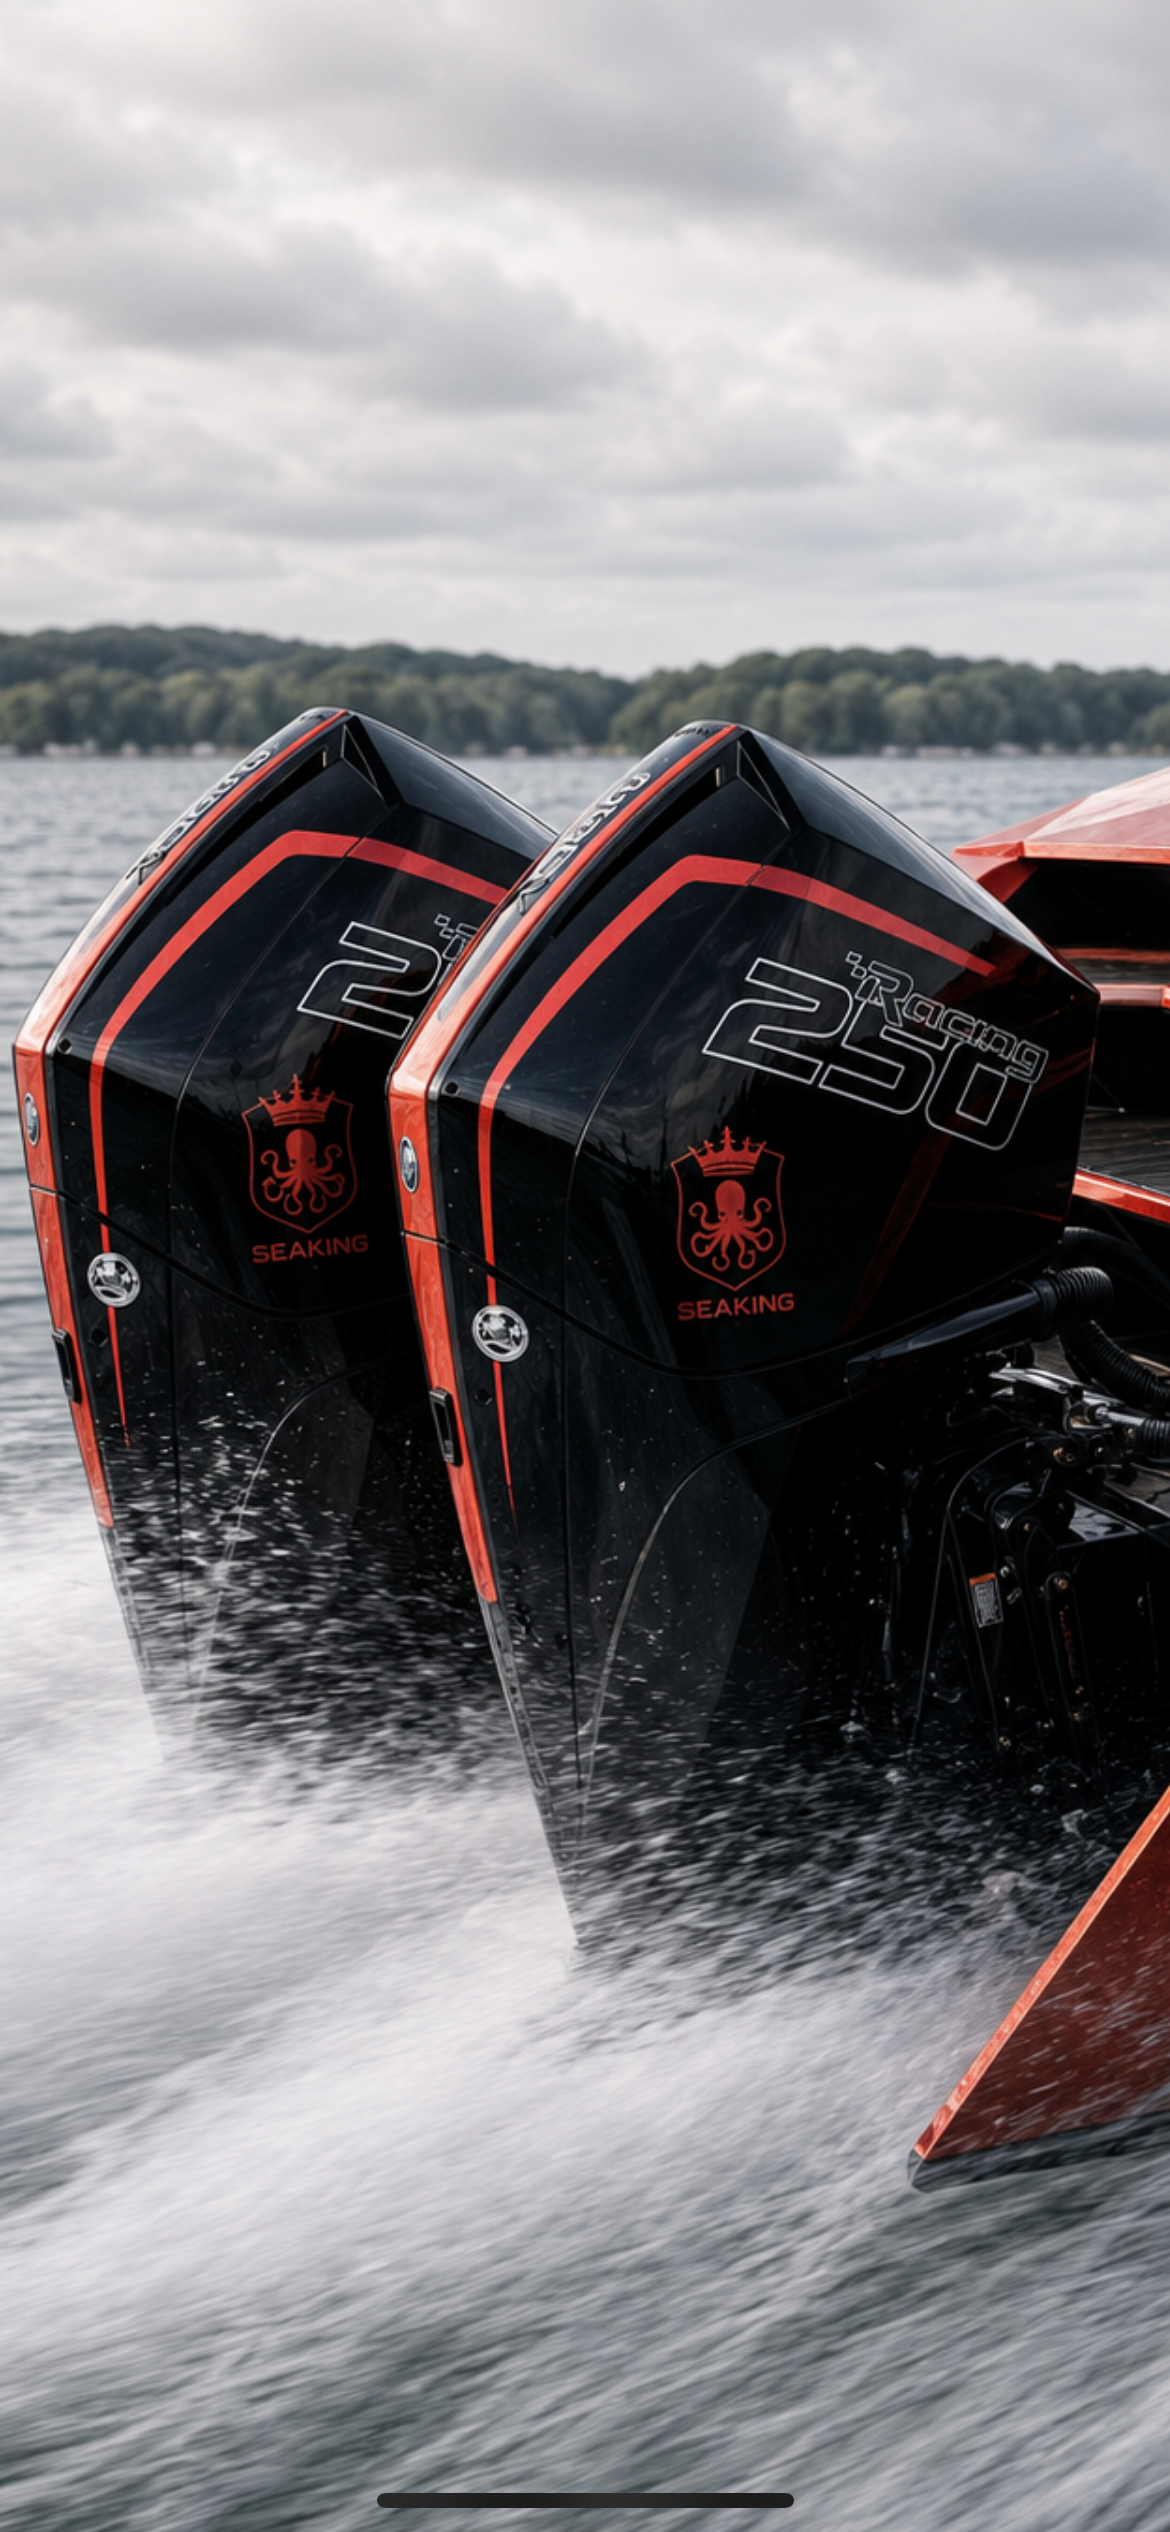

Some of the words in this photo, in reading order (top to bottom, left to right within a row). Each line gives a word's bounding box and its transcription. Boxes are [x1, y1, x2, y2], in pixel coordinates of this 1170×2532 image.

[297, 921, 452, 1040] 2
[854, 960, 1049, 1084] Racing
[702, 956, 1034, 1151] 250
[251, 1234, 369, 1263] SEAKING
[677, 1292, 795, 1321] SEAKING
